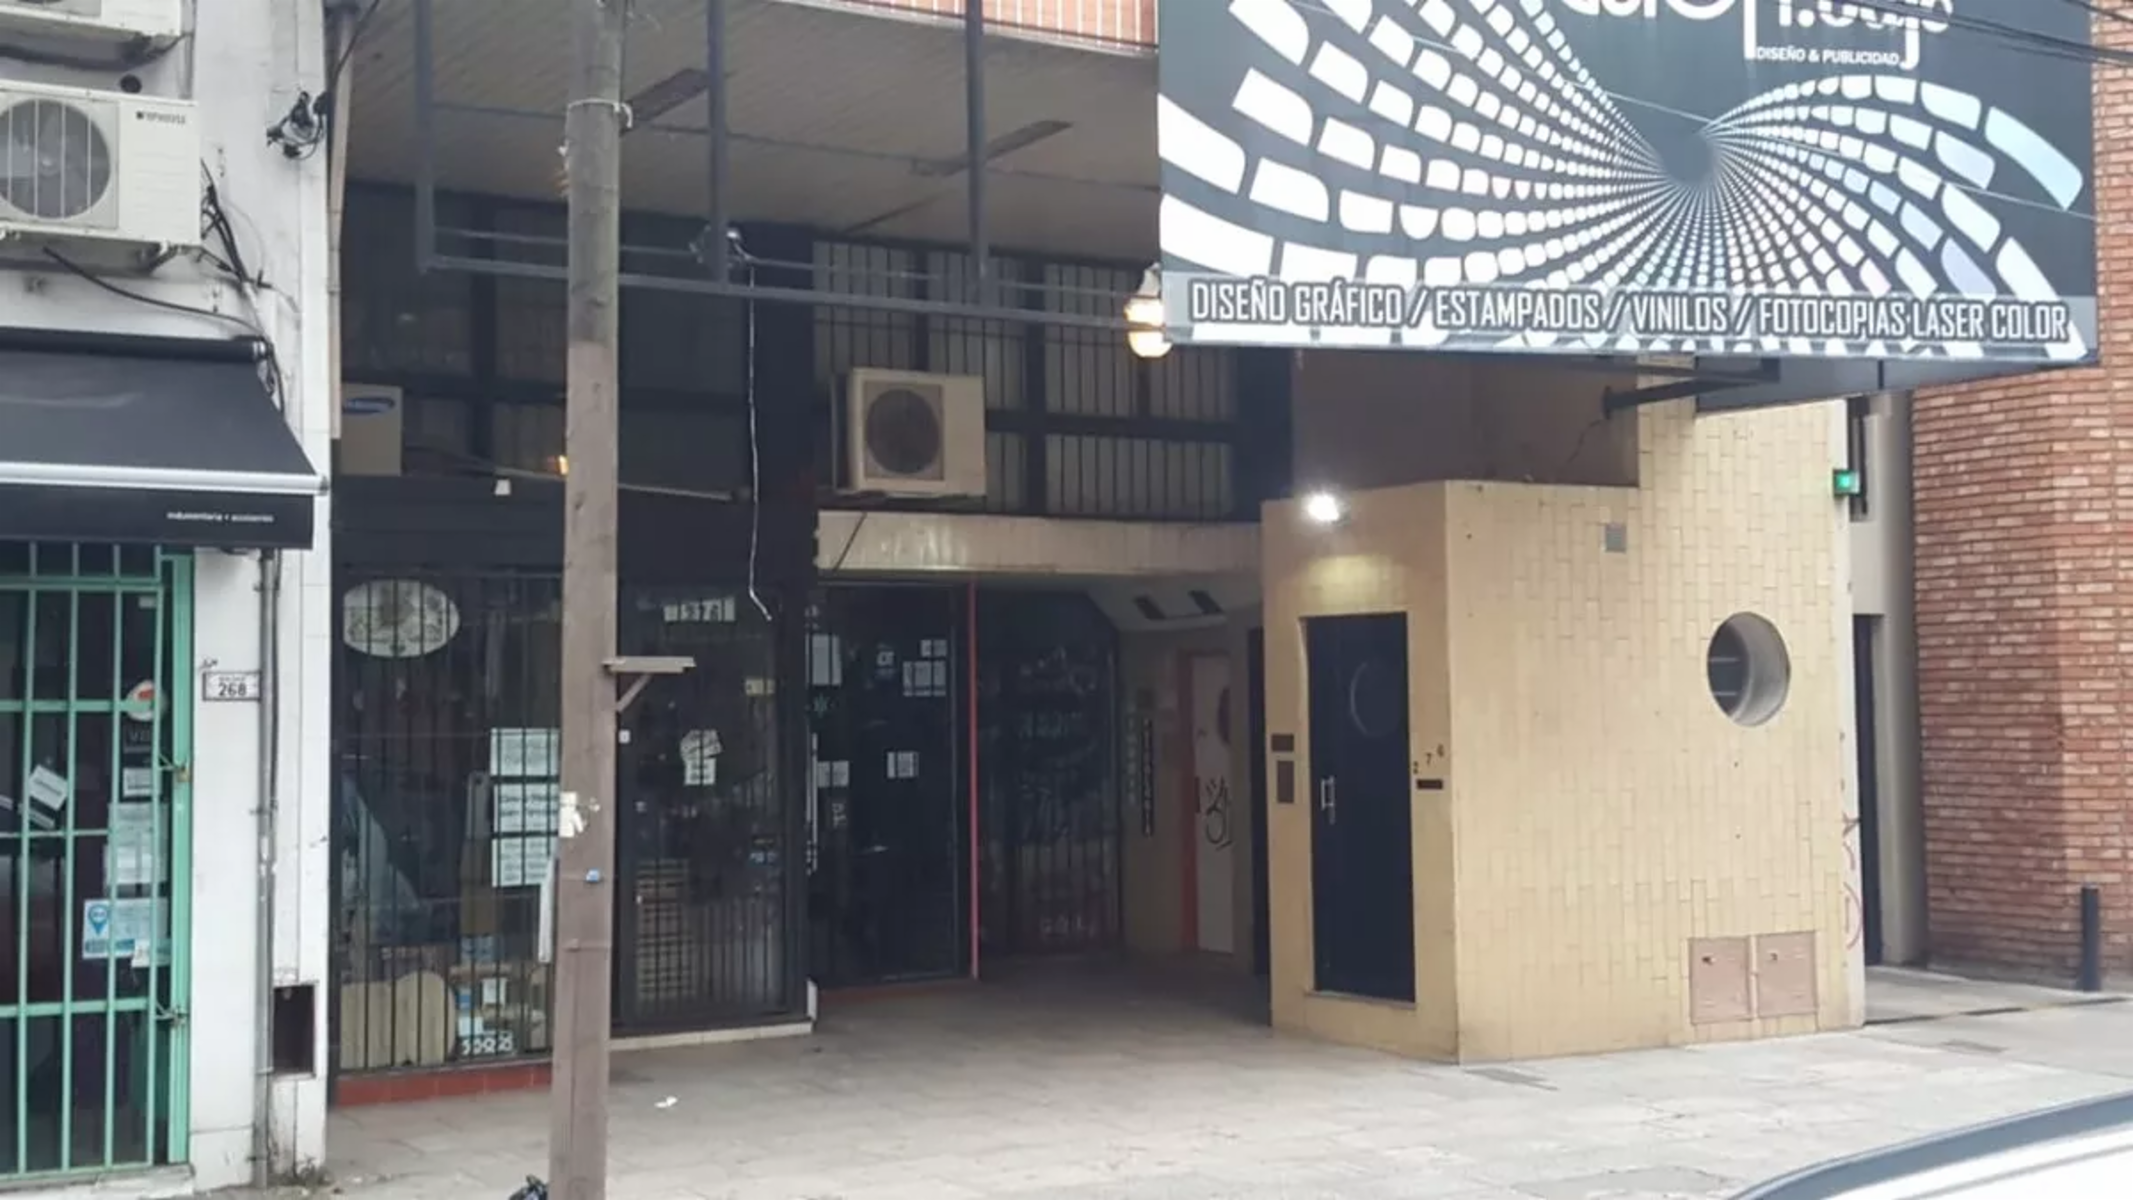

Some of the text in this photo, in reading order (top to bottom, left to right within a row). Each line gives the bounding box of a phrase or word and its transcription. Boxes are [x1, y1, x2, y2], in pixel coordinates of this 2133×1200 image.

[1756, 45, 1899, 65] DISEÑO & PUBLICIDAD
[1191, 279, 1286, 321] DISEÑO
[1294, 279, 1401, 324] GRÁFICO
[1435, 290, 1600, 329] ESTAMPADOS
[1631, 295, 1729, 332] VINILOS
[1759, 298, 1906, 336] FOTOCOPIAS
[1912, 302, 1984, 338] LASER
[1990, 303, 2067, 340] COLOR
[218, 682, 247, 697] 268
